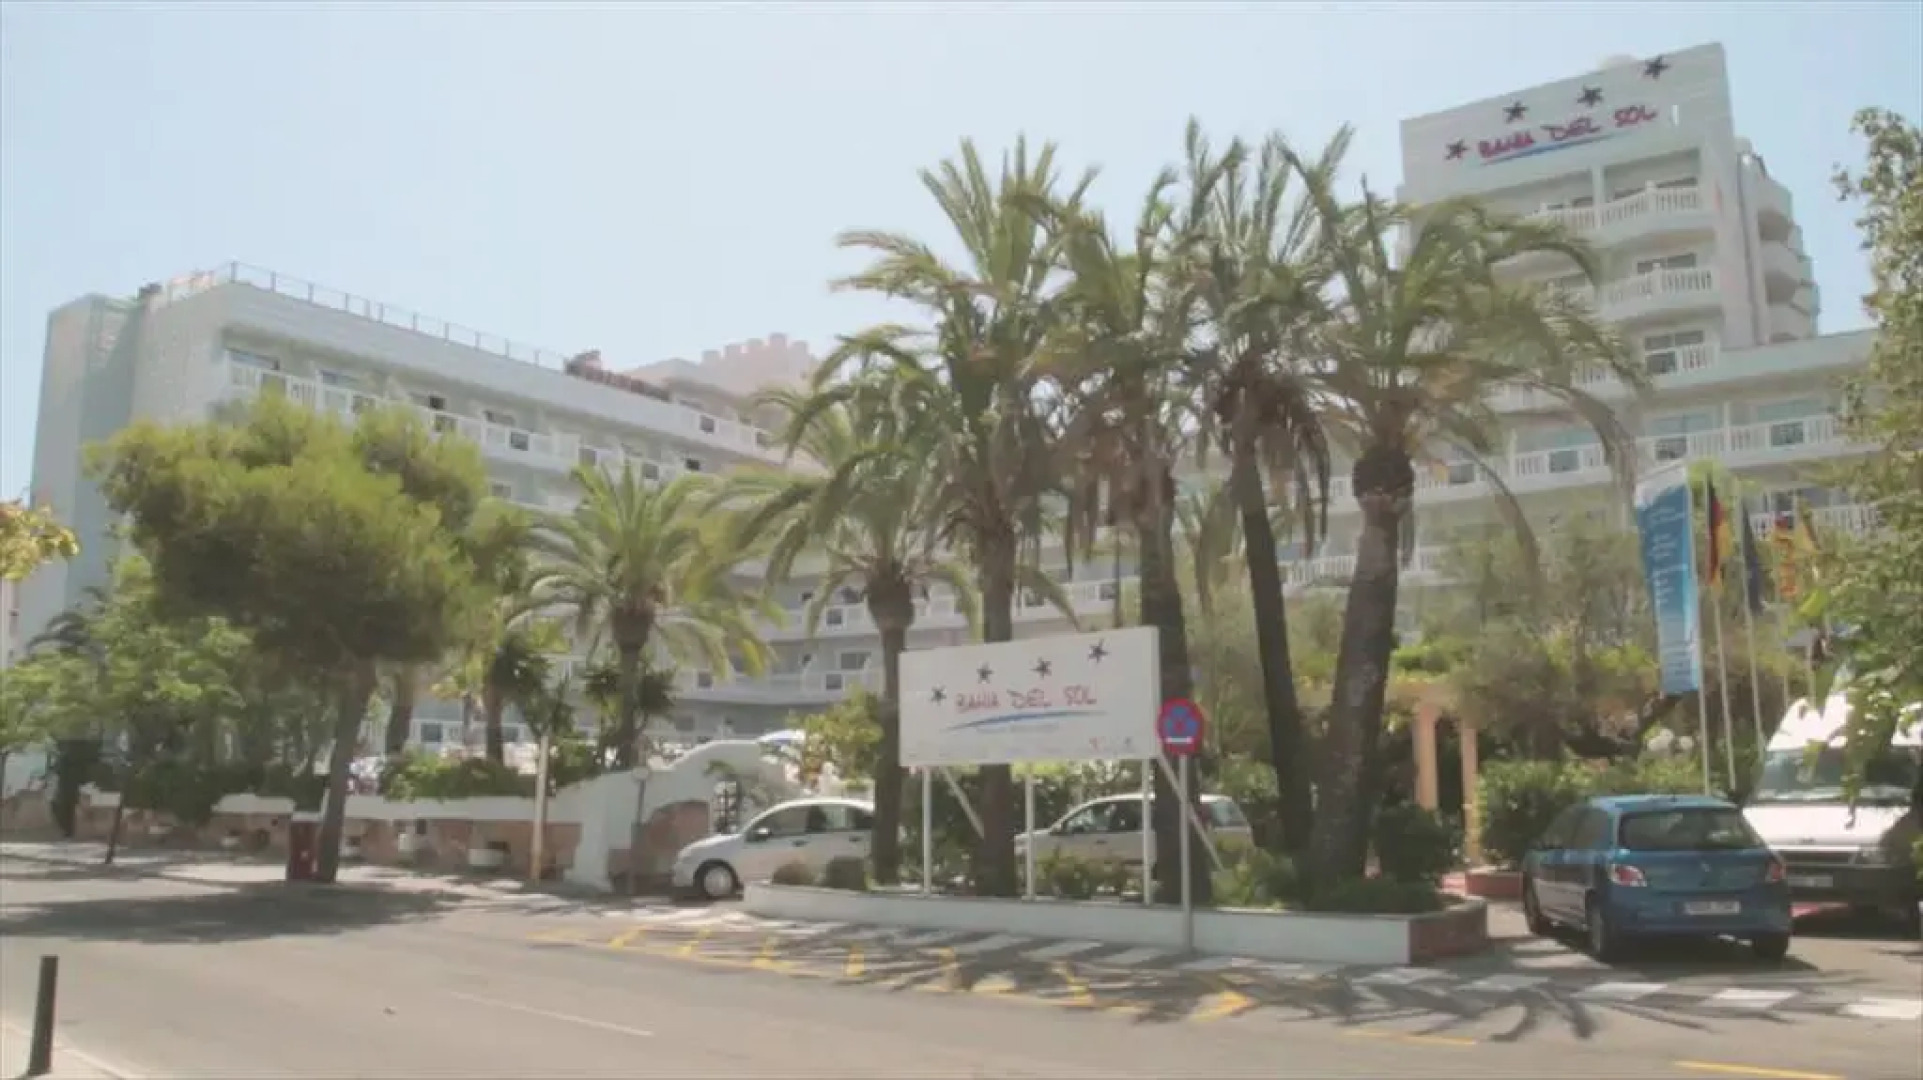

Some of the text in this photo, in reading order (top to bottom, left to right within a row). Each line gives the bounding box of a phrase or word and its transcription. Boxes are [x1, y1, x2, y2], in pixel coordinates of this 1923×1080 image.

[1540, 116, 1602, 141] DEL
[1613, 104, 1658, 127] SOL
[1007, 687, 1052, 708] DEL
[1063, 684, 1098, 706] SOL
